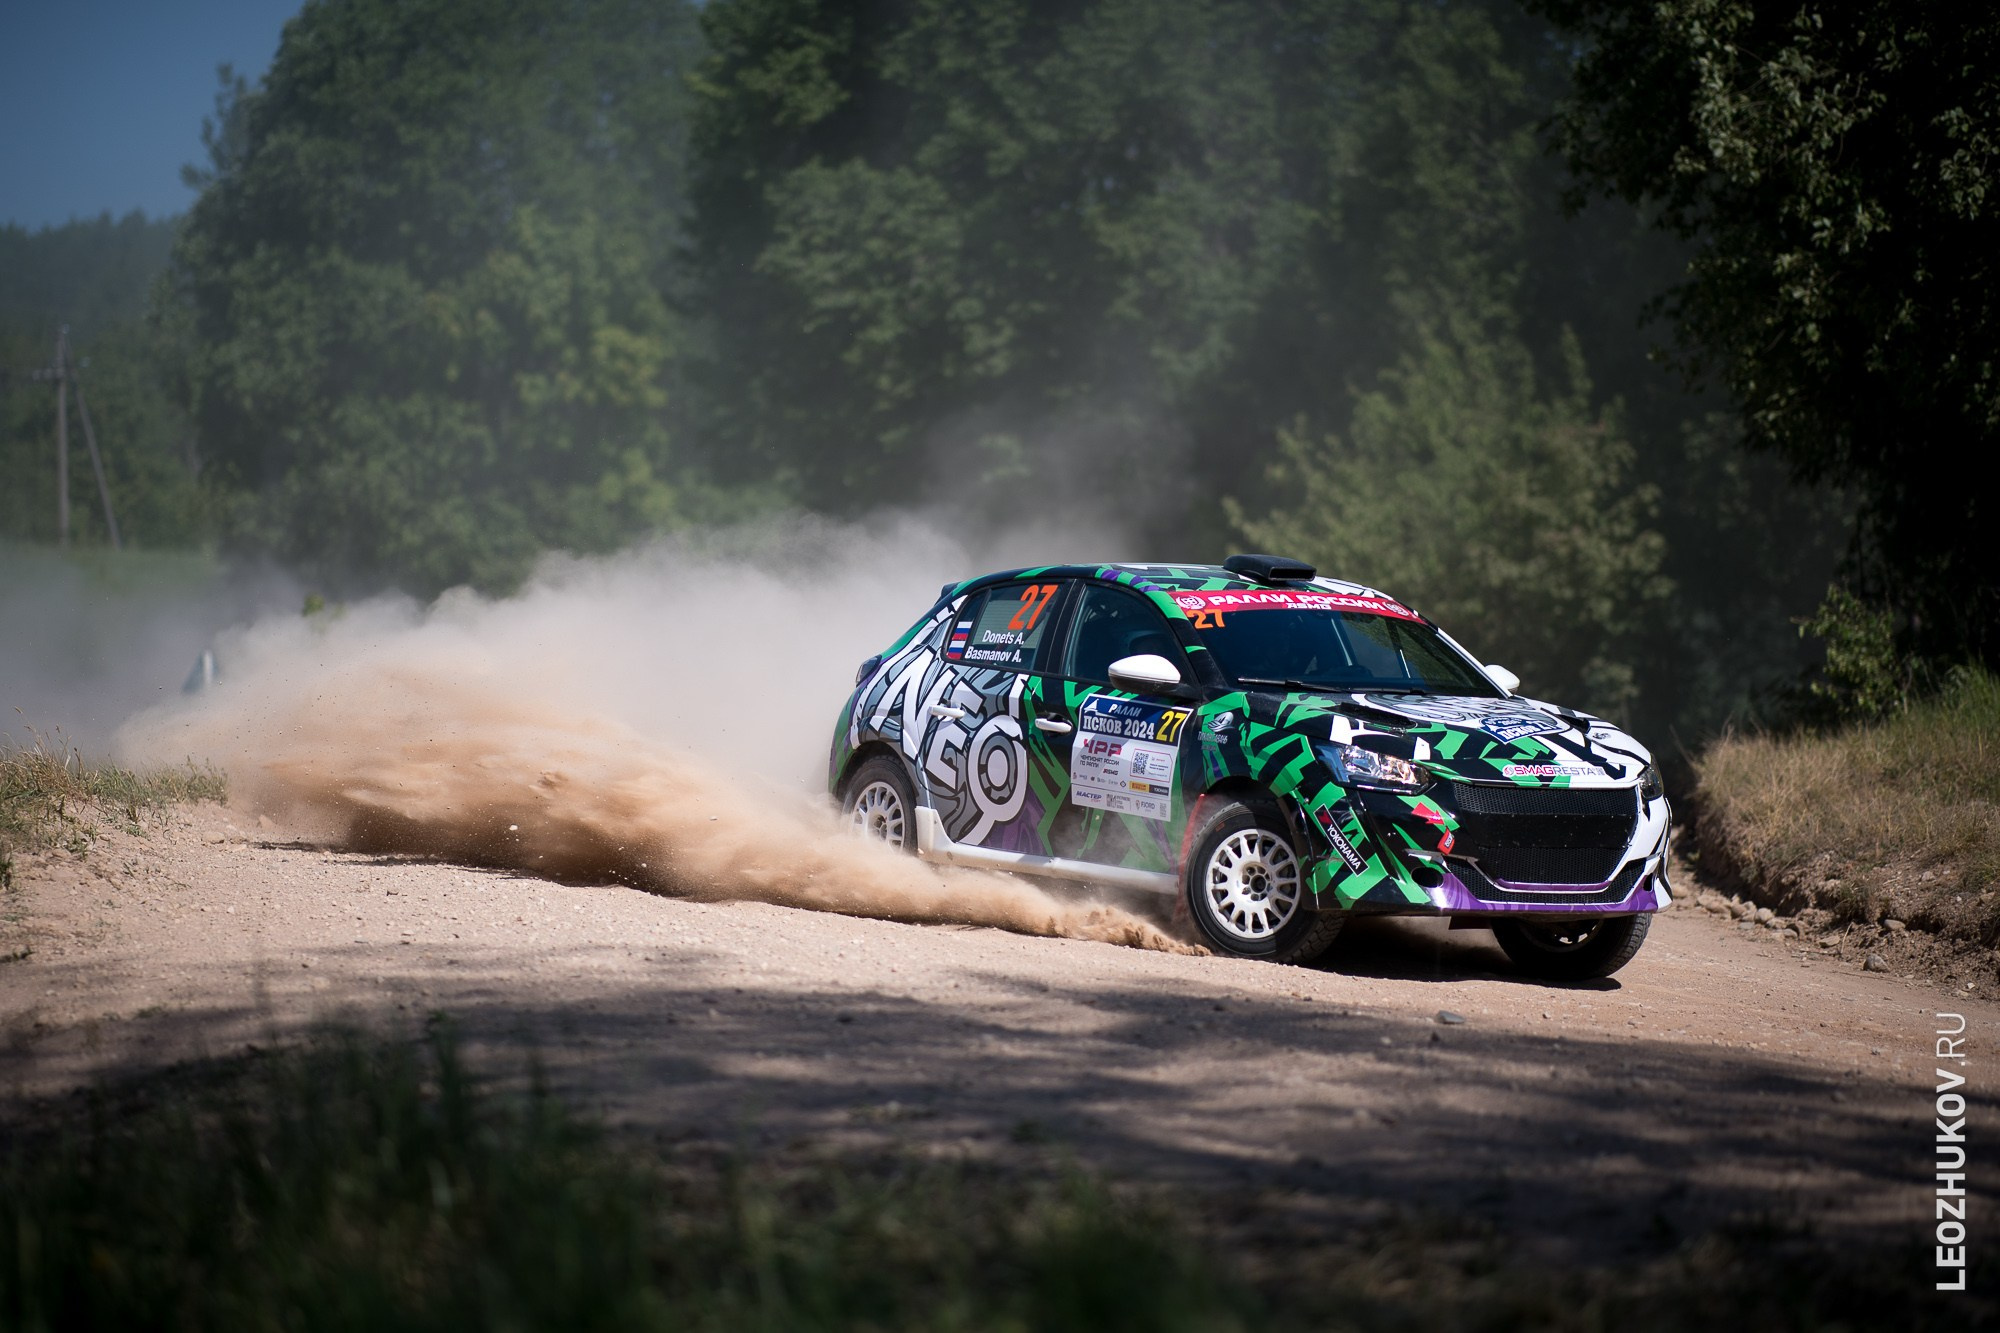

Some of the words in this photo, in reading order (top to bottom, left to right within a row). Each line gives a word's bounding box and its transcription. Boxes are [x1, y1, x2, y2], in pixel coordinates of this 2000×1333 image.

[1007, 584, 1059, 630] 27
[1207, 593, 1294, 606] РАЛЛИ
[1296, 594, 1386, 611] РОССИИ
[1186, 608, 1226, 630] 27
[982, 629, 1015, 645] Donets
[1013, 631, 1025, 646] A.
[964, 645, 1013, 662] Basmanov
[1011, 648, 1022, 663] A.
[1108, 703, 1142, 717] РАЛЛИ
[1082, 715, 1122, 734] ПСКОВ
[1123, 718, 1155, 741] 2024
[1155, 710, 1188, 743] 27
[1083, 738, 1122, 757] ЧРР
[1076, 790, 1102, 800] МАСТЕР
[1327, 824, 1361, 870] YOKOHAMA
